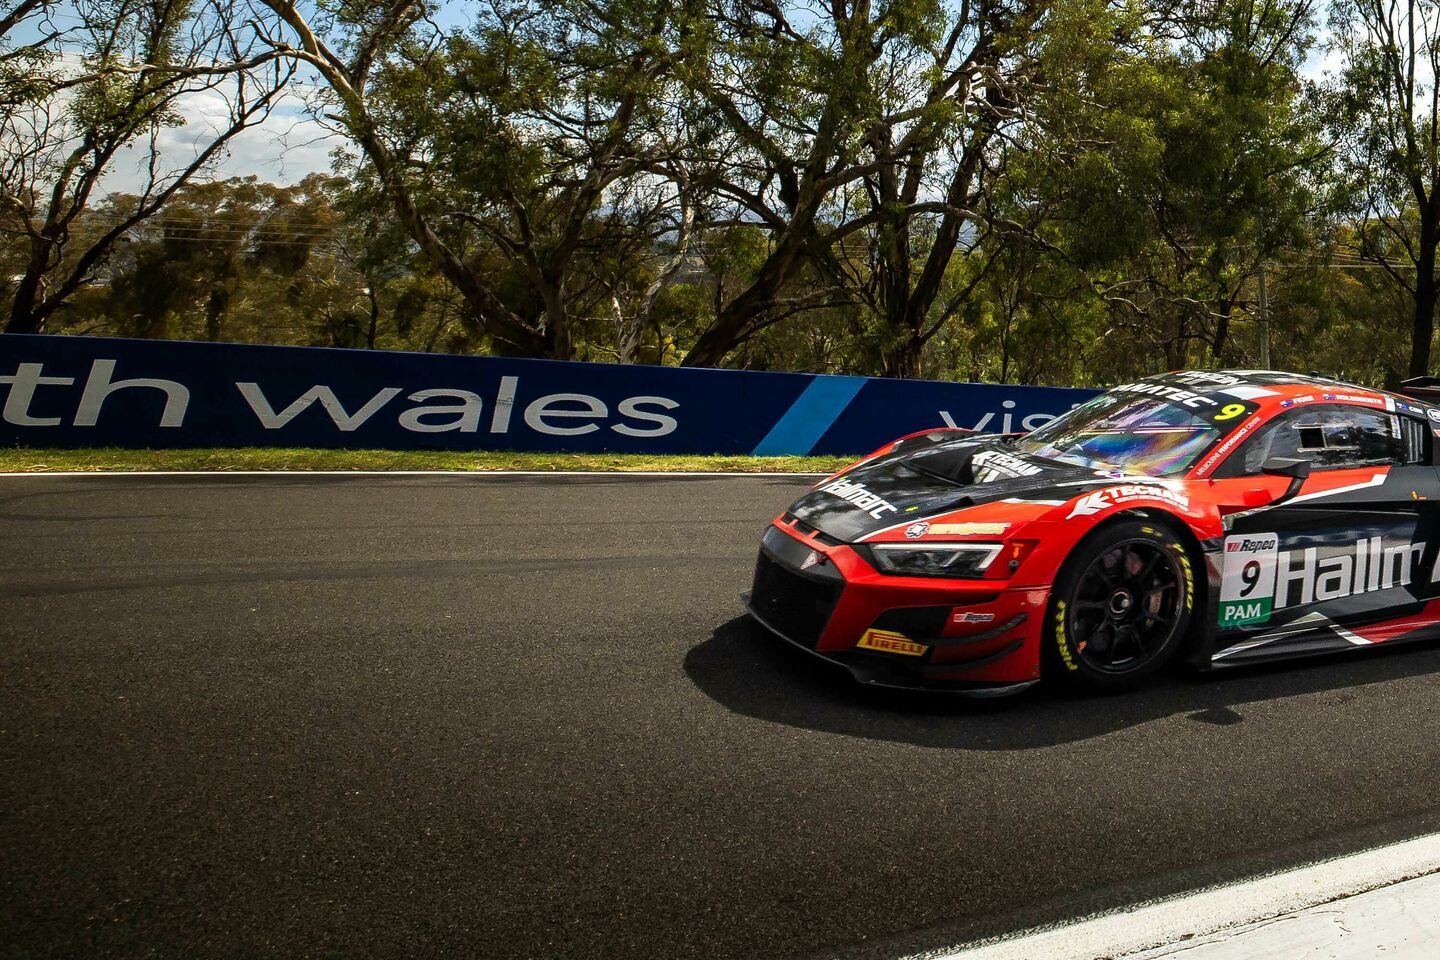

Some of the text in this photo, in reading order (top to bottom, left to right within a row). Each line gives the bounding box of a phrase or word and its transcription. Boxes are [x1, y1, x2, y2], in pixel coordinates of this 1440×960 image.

[235, 375, 679, 438] wales
[1213, 403, 1247, 421] 9
[818, 479, 898, 519] Hallmarc
[1240, 539, 1276, 554] Repco
[1240, 560, 1261, 597] 9
[1224, 602, 1262, 621] PAM
[868, 631, 922, 653] PIRELLI
